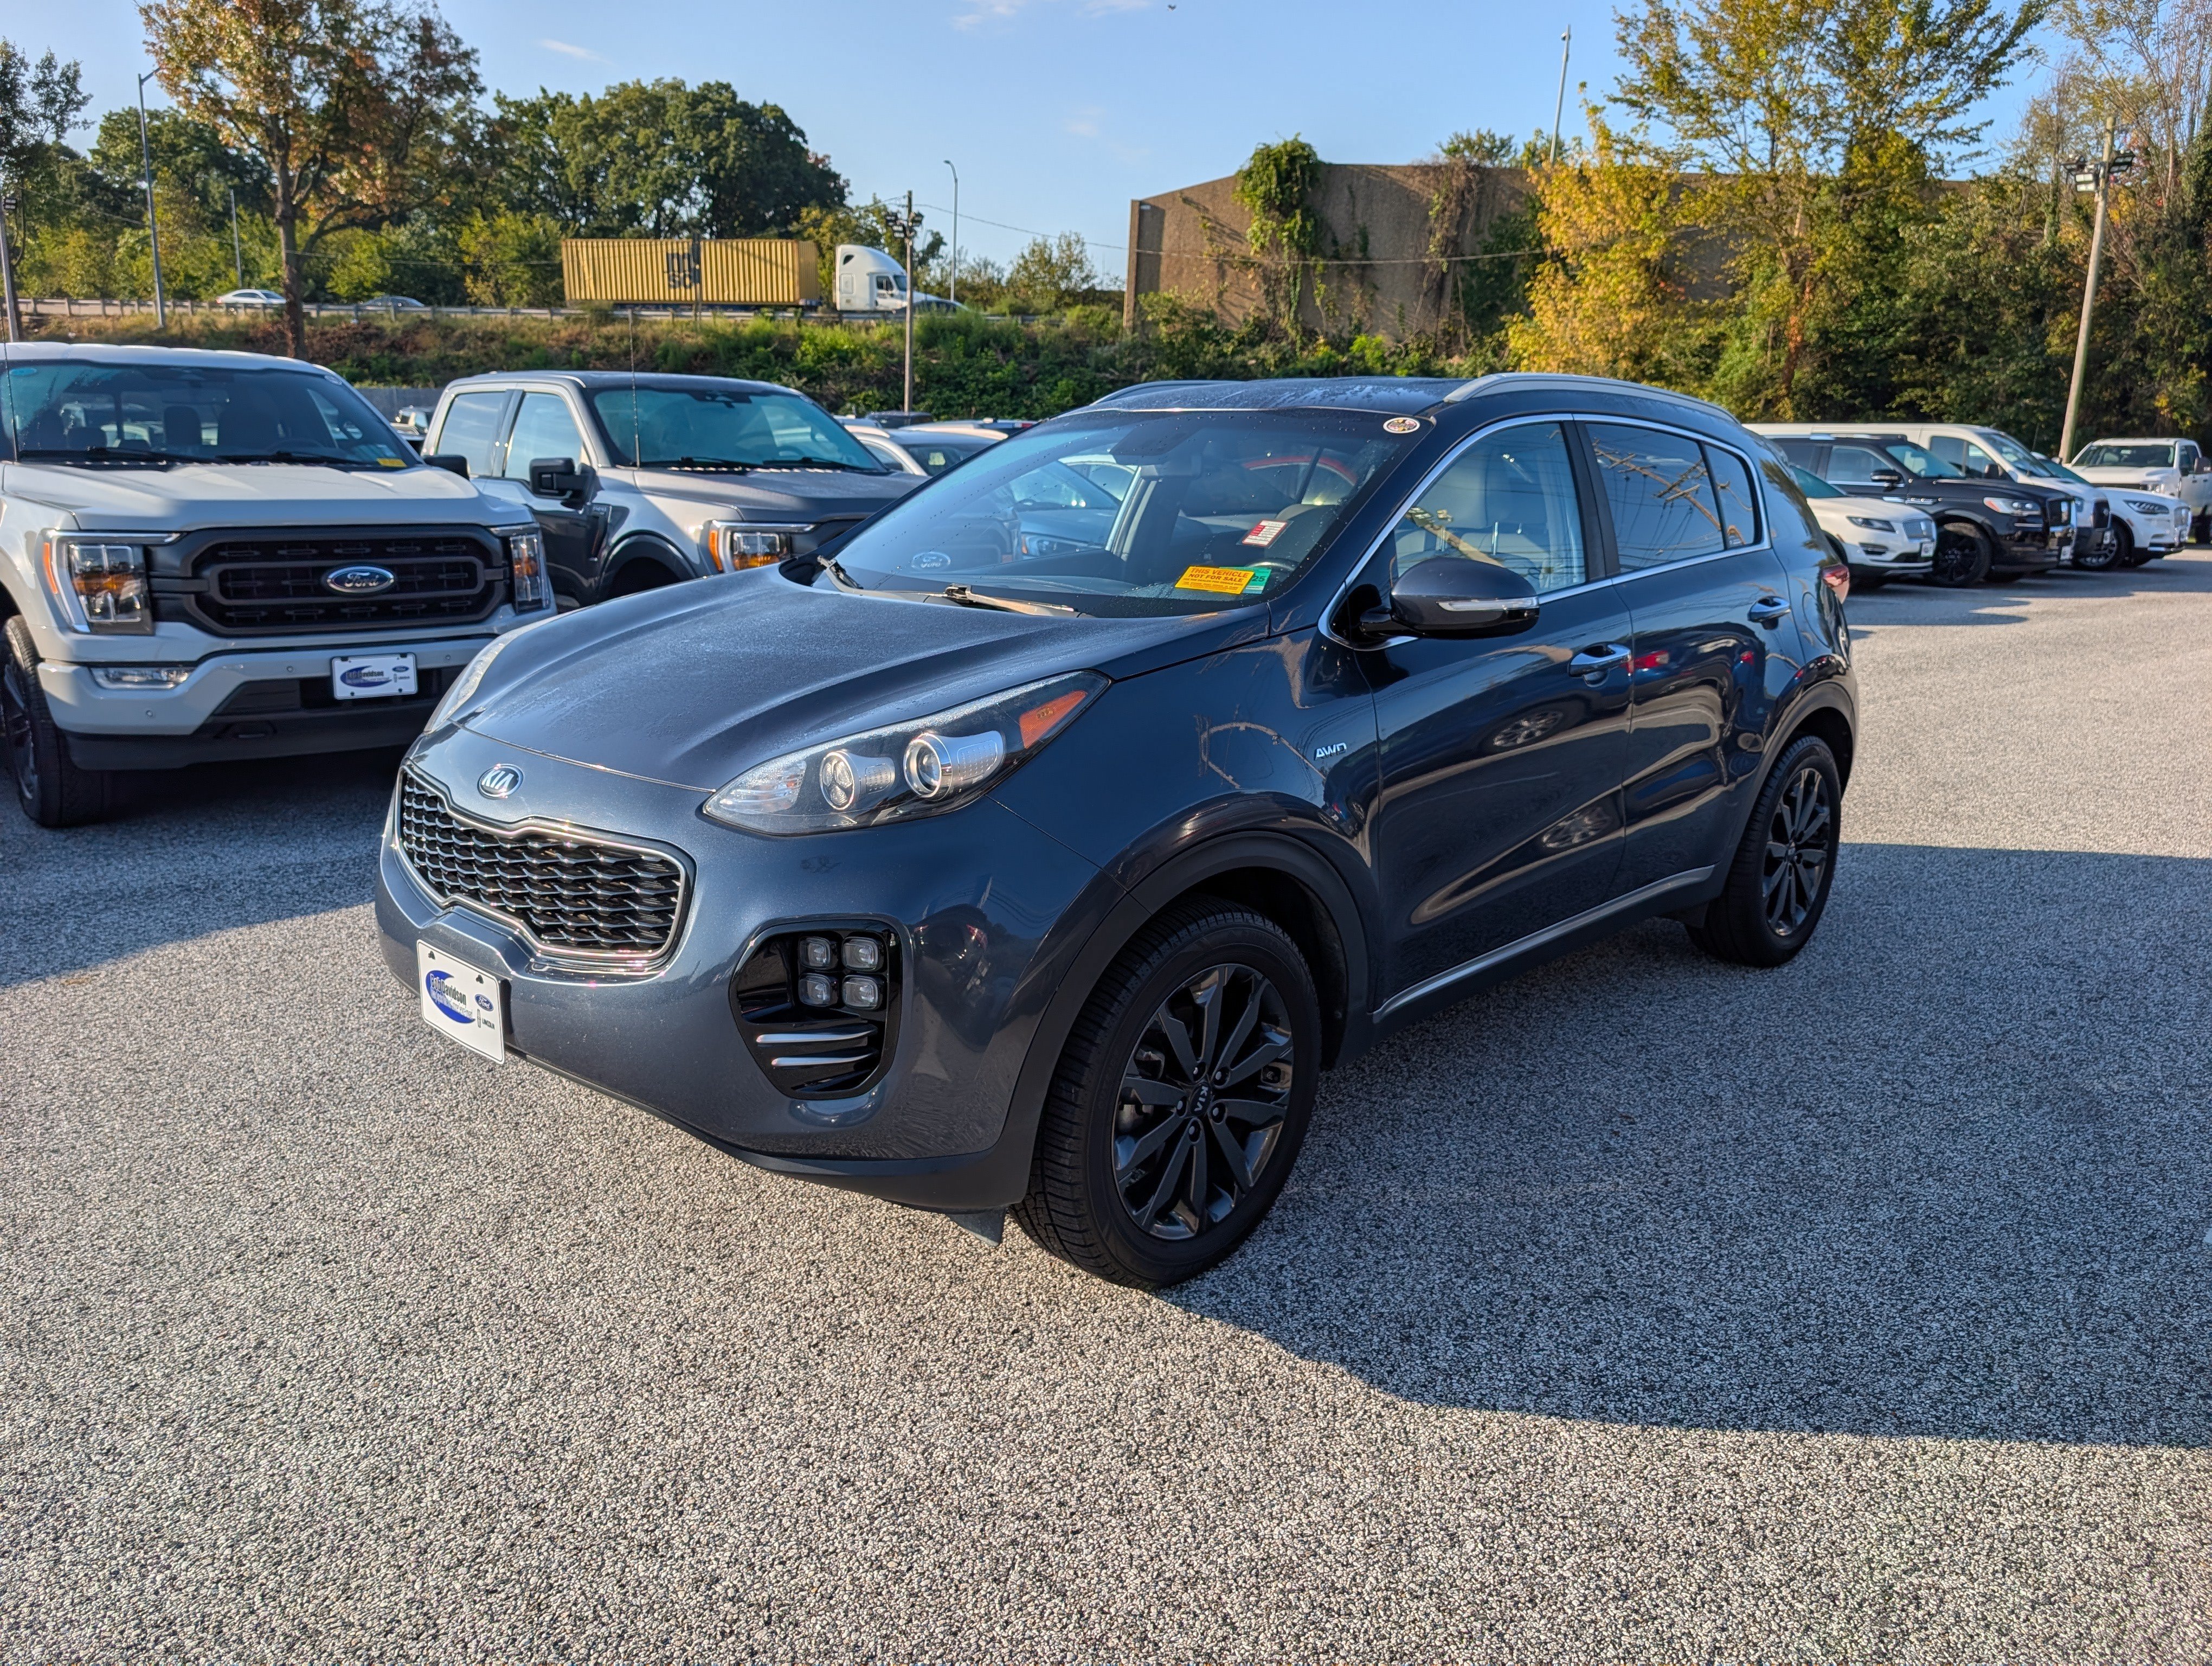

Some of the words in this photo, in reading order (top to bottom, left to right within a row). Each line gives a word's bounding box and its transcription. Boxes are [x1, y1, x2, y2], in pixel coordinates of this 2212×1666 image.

[344, 572, 379, 587] Ford
[1212, 569, 1250, 578] VEHICLE
[1316, 742, 1347, 758] AWD
[481, 770, 514, 792] KIA
[441, 979, 467, 1005] Davidson
[479, 996, 490, 1009] Ford
[1194, 1086, 1208, 1111] KIA
